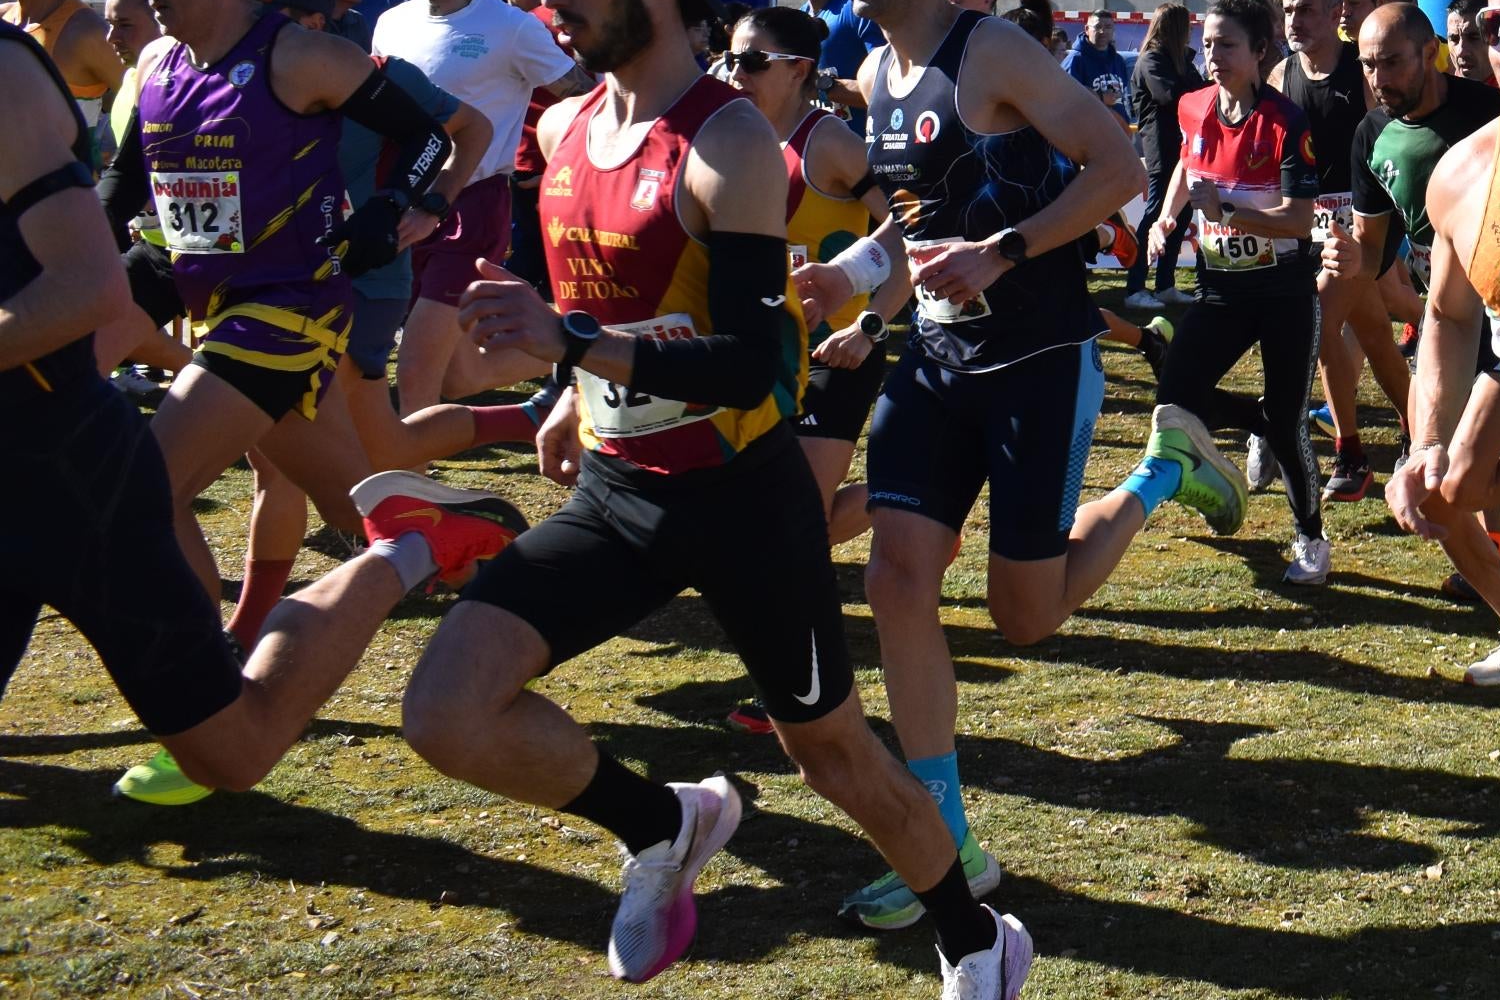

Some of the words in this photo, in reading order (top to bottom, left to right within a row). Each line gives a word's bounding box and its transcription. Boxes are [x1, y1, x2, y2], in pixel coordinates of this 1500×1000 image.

[194, 134, 235, 148] PRIM
[185, 156, 243, 170] Macotera
[412, 133, 443, 177] TERREX
[153, 177, 238, 198] bedunia
[168, 202, 220, 233] 312
[1215, 235, 1259, 258] 150
[559, 280, 577, 300] DE
[1300, 425, 1316, 473] adidas
[869, 490, 921, 507] HARRO
